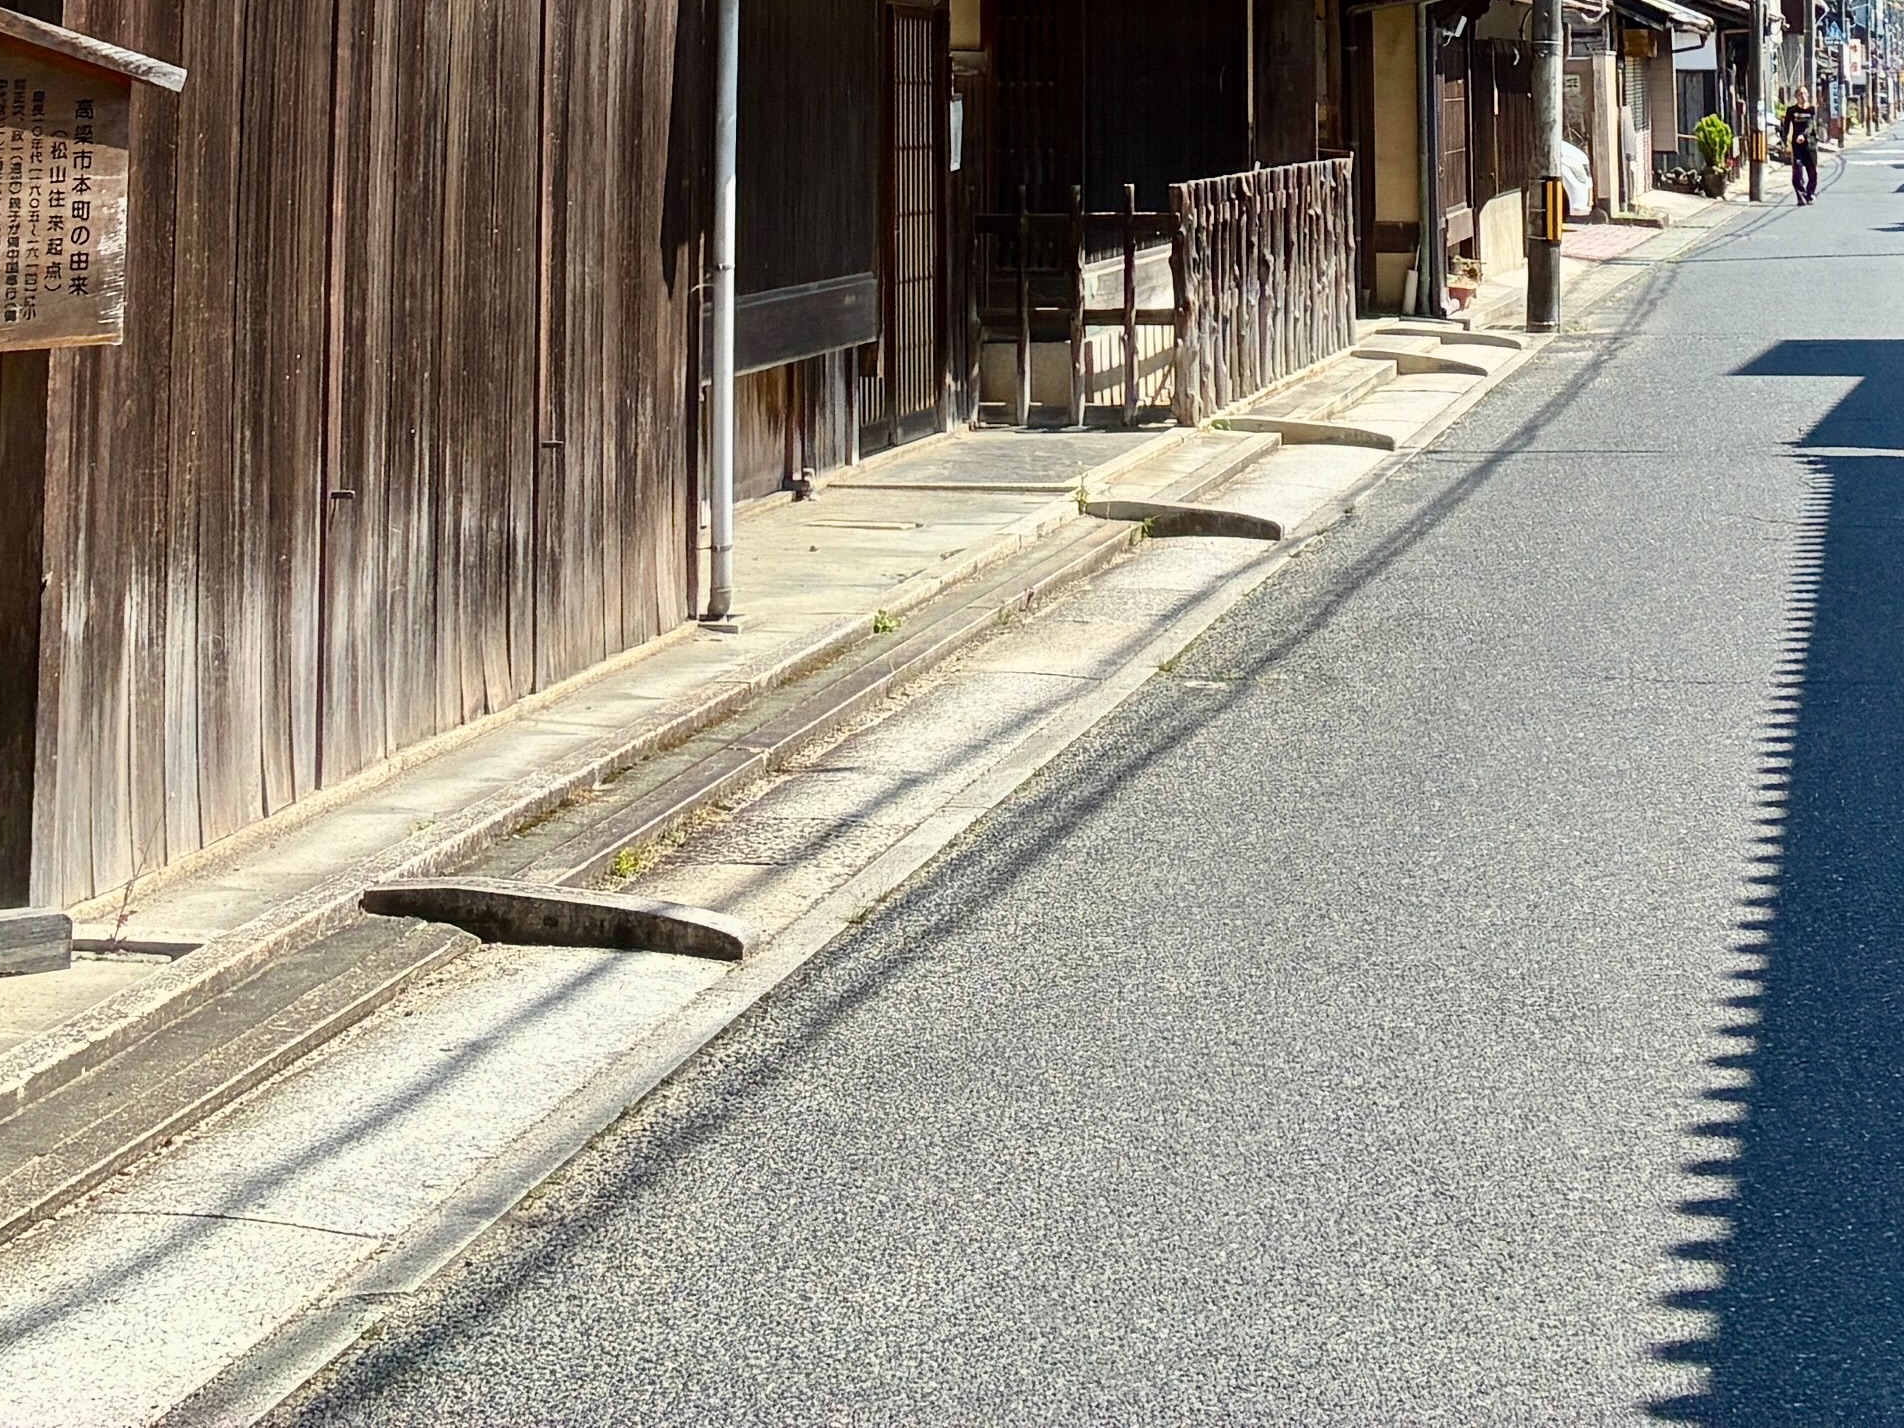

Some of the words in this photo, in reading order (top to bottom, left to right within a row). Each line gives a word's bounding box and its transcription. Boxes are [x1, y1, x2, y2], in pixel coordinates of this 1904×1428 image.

[44, 130, 68, 292] （松山往来起点）
[69, 99, 94, 296] 高梁市本町の由来
